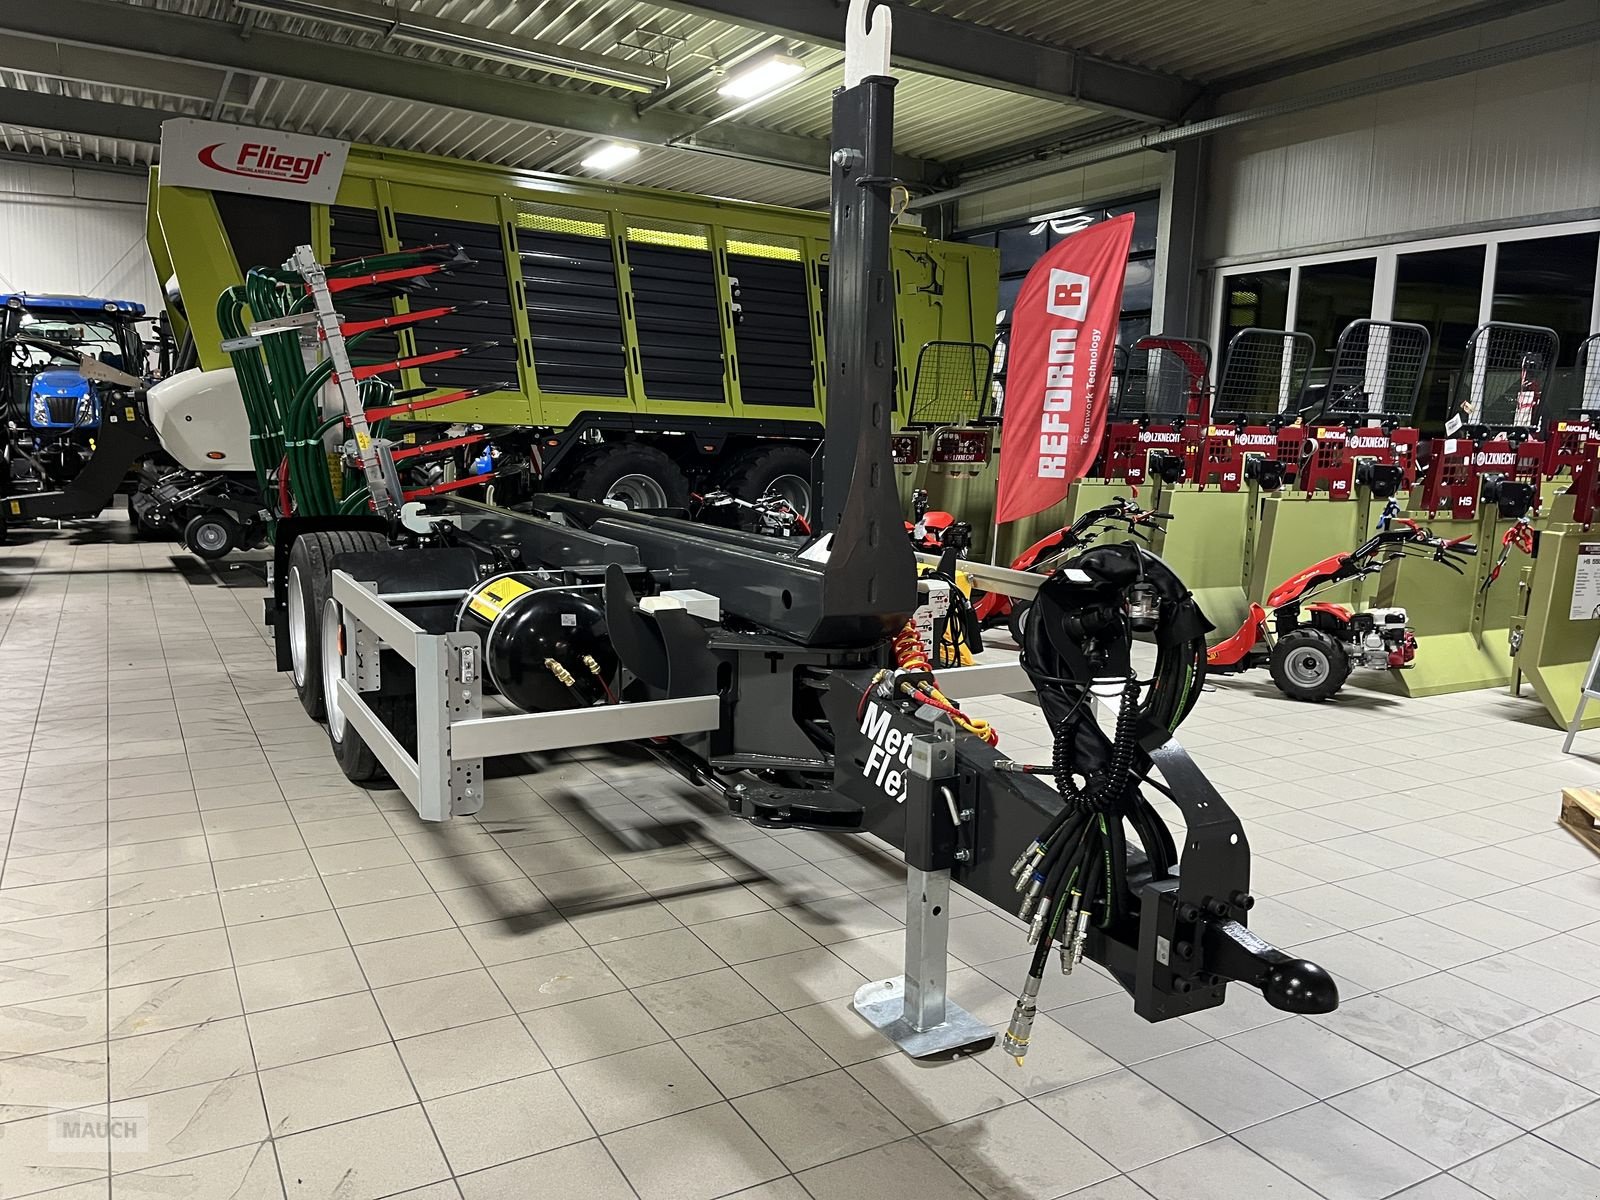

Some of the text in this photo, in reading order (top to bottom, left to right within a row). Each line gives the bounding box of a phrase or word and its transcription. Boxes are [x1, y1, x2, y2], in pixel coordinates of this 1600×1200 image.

[237, 143, 324, 180] Fliegl
[1080, 328, 1102, 446] Teamwork Technology
[1038, 328, 1078, 478] REFORM
[1138, 431, 1181, 443] HOLZKNECHT
[1234, 433, 1278, 446] HOLZKNECHT
[1345, 435, 1391, 449] HOLZKNECHT
[1471, 451, 1517, 466] HOLZKNECHT
[1128, 468, 1141, 477] HS
[1223, 472, 1236, 482] HS
[1332, 480, 1346, 490] HS
[1458, 496, 1473, 507] HS
